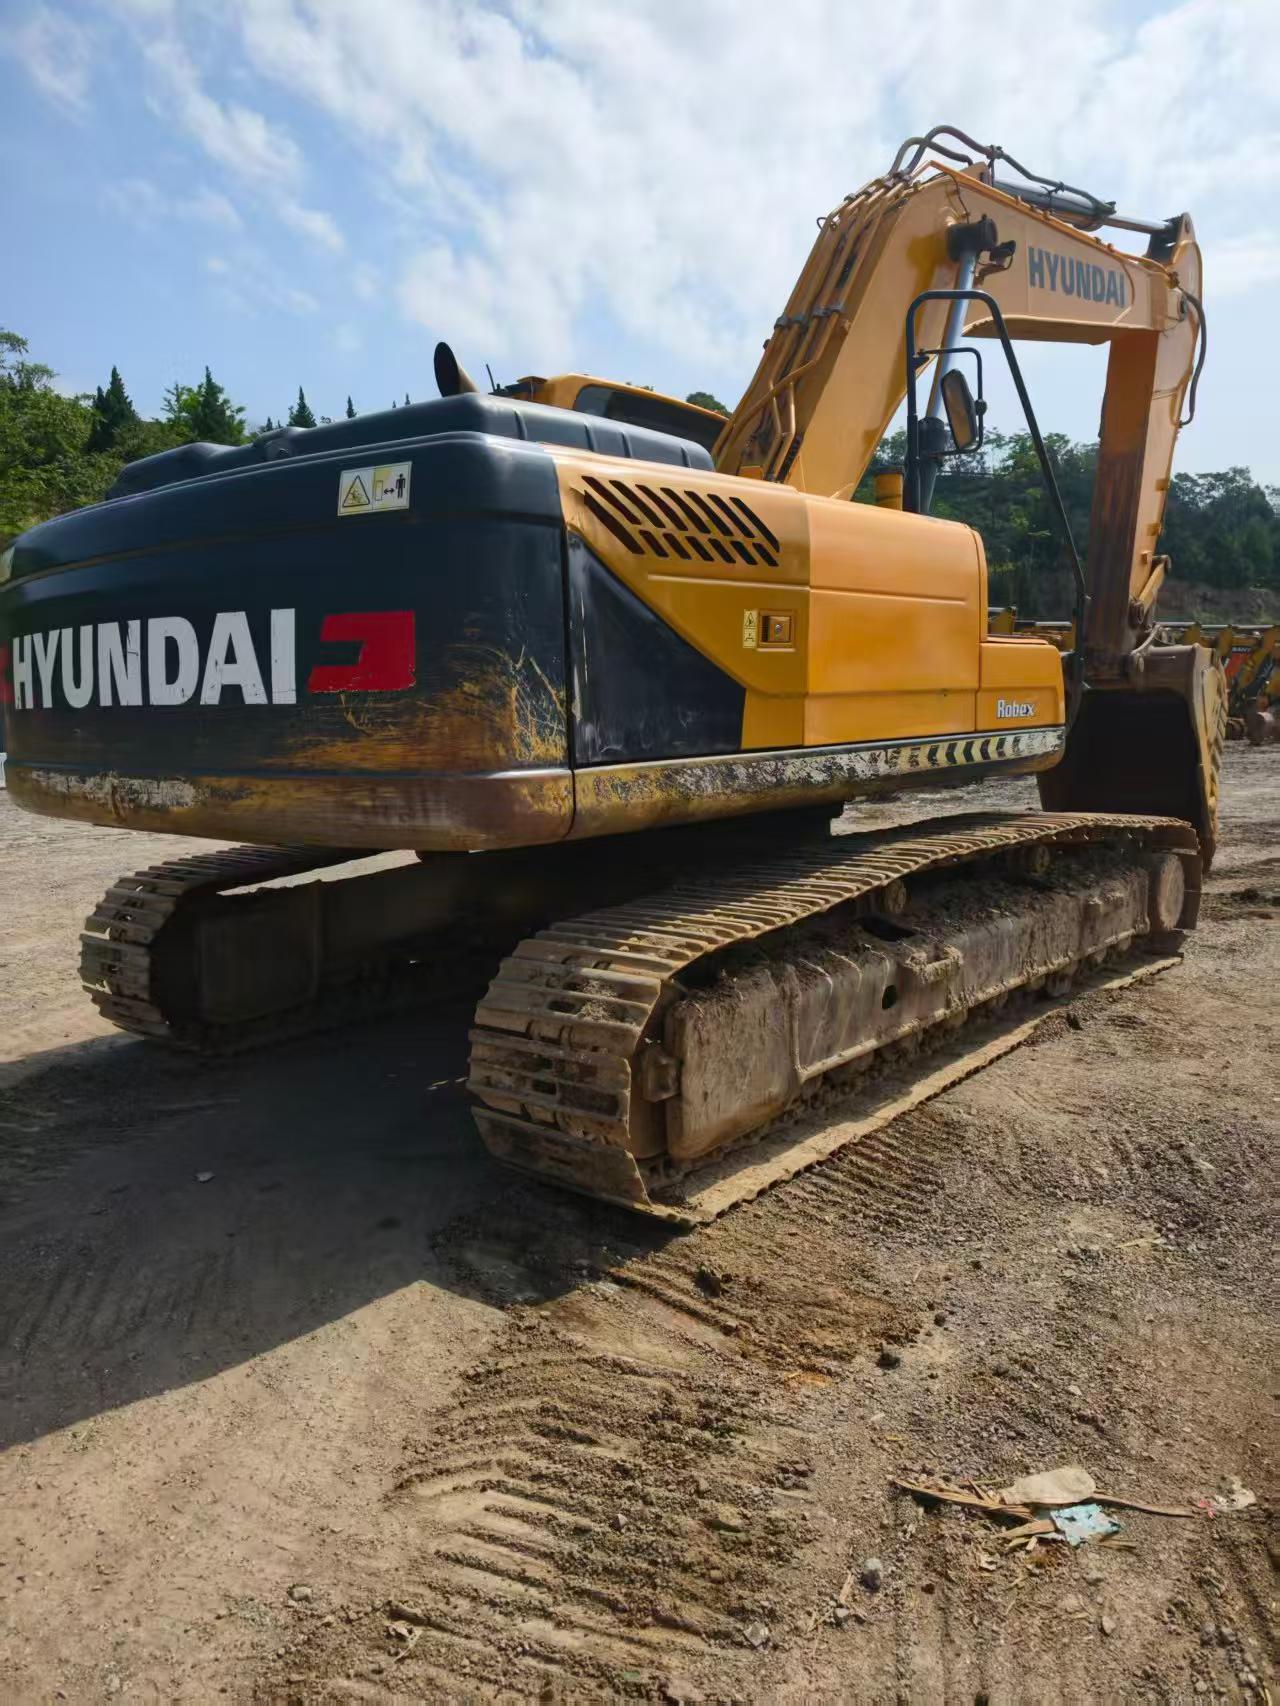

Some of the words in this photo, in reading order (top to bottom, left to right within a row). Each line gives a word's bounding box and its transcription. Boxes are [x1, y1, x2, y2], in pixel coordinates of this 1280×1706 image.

[1028, 246, 1125, 309] HYUNDAI
[12, 608, 297, 709] HYUNDAI
[997, 699, 1035, 718] Robex
